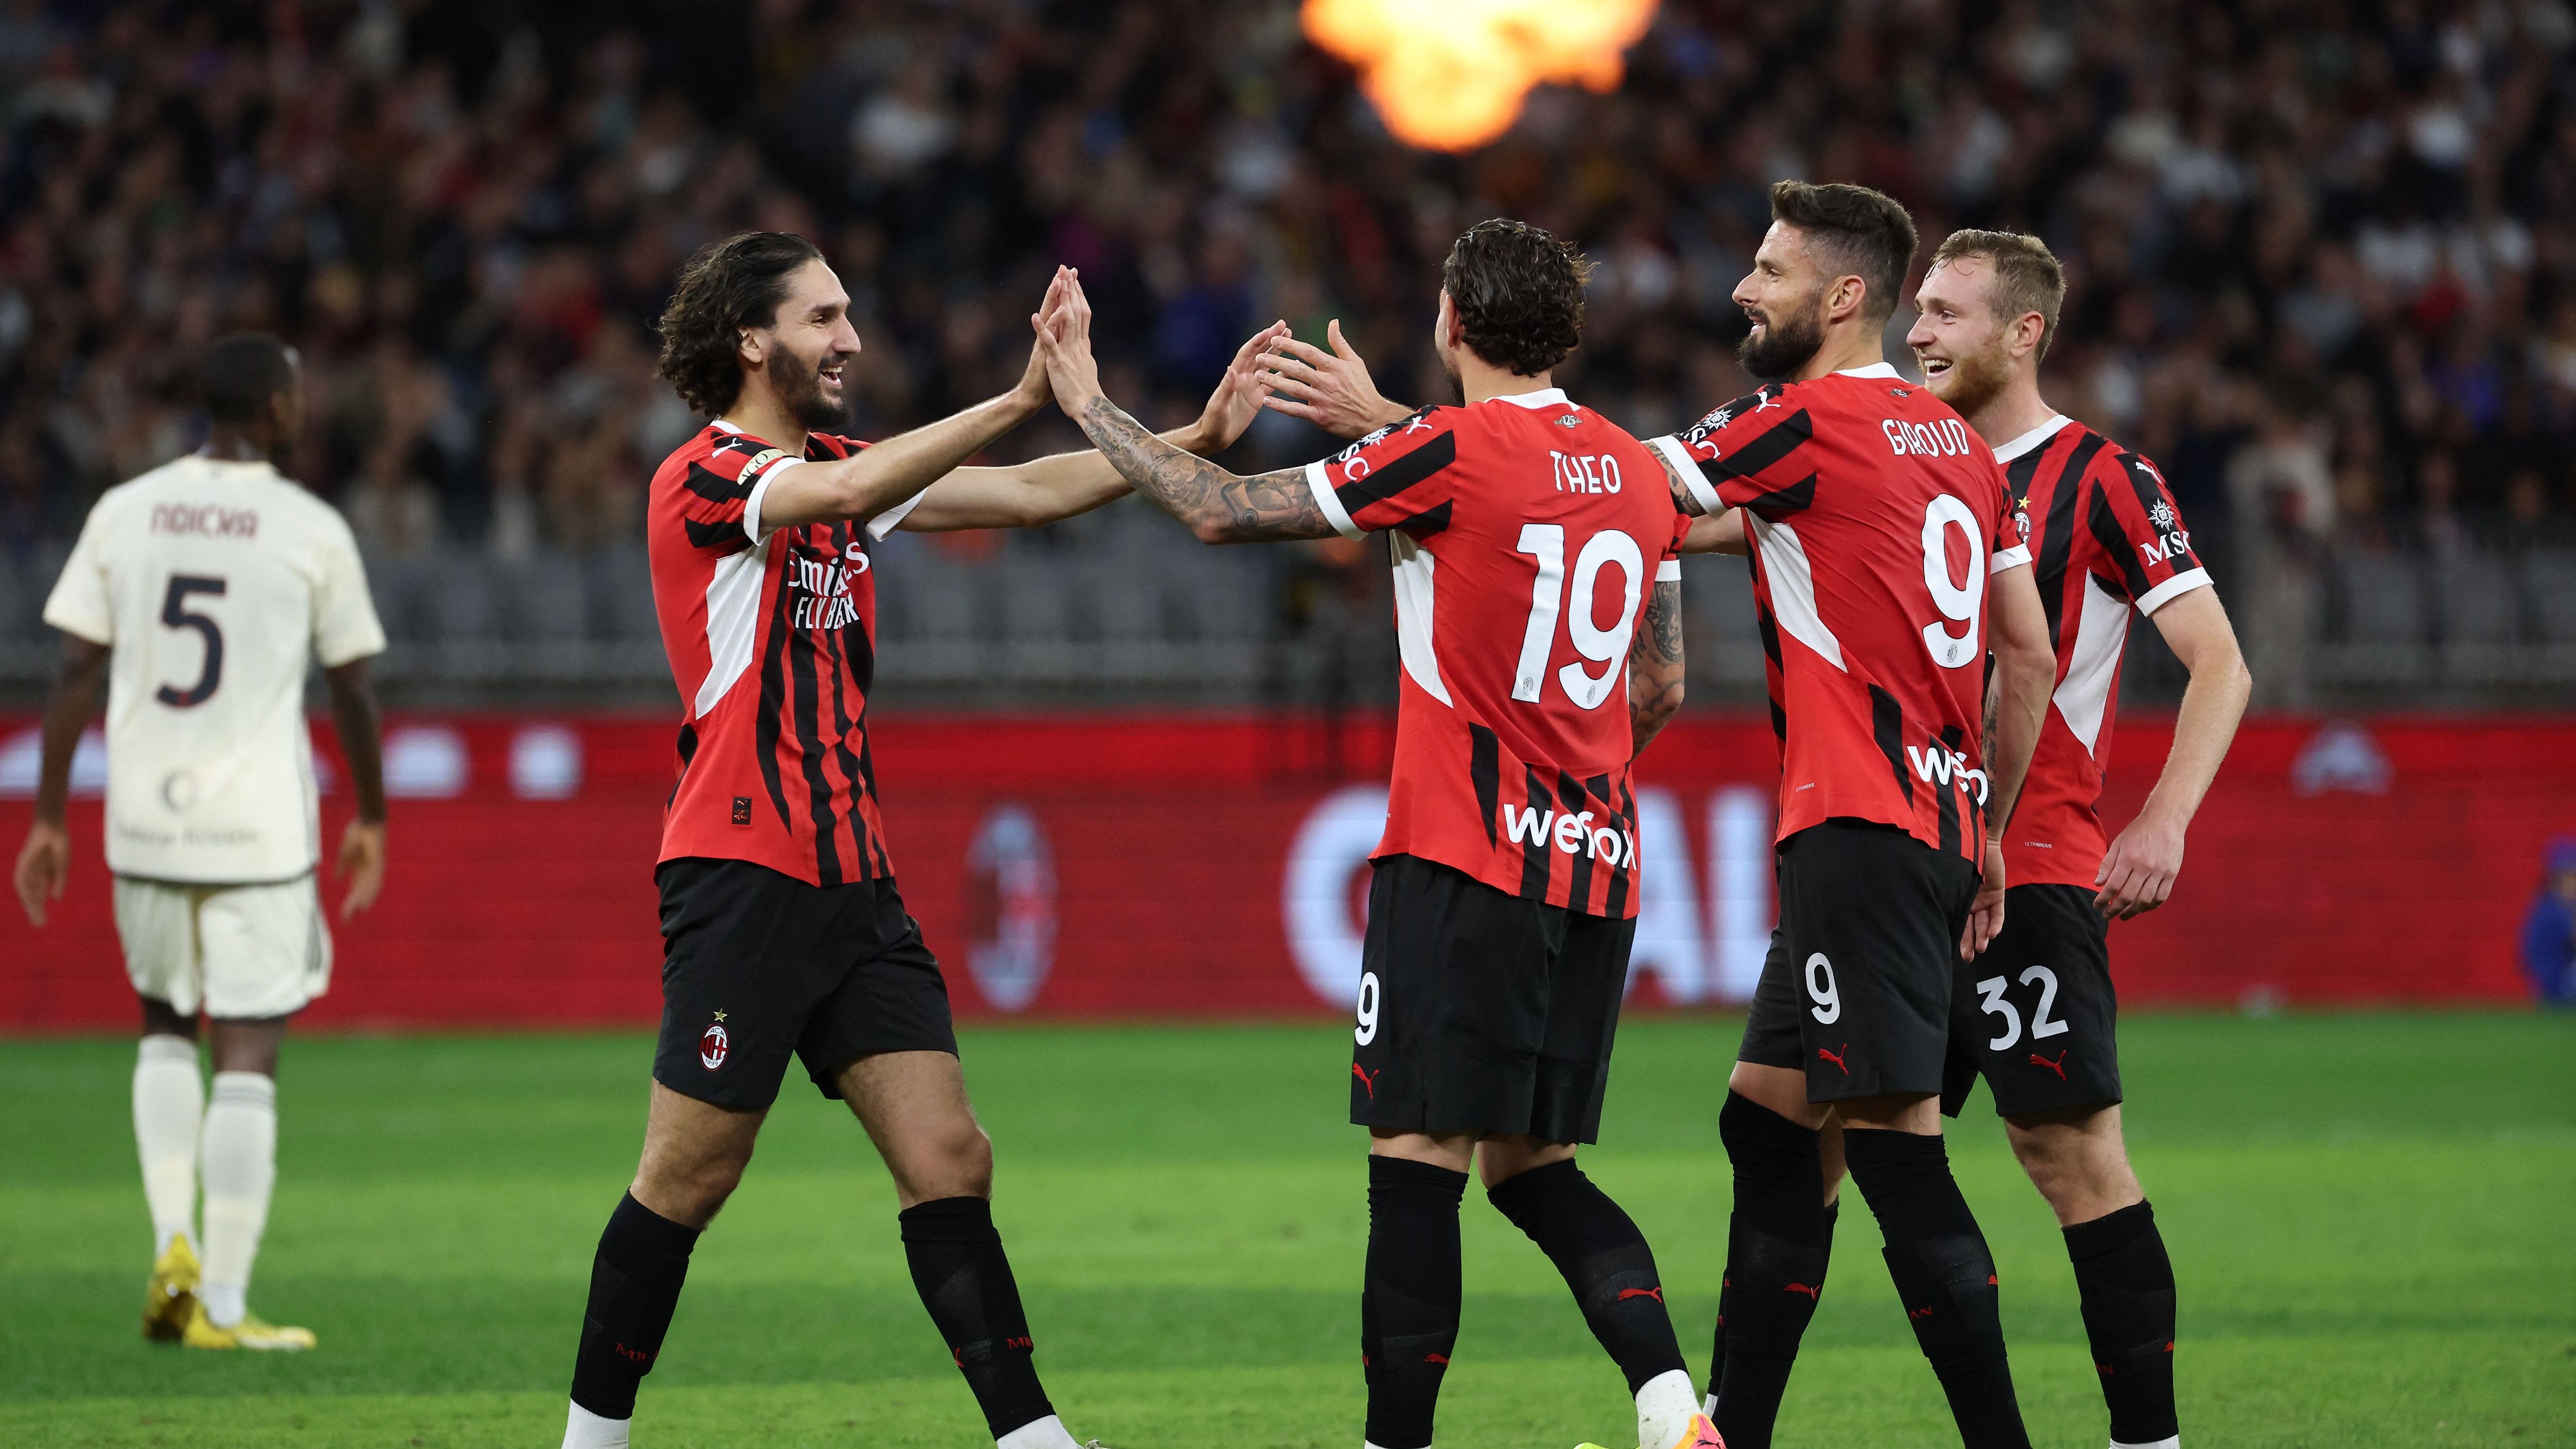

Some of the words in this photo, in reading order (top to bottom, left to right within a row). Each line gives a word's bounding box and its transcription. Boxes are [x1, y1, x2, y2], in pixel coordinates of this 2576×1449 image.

[1338, 443, 1370, 480] SC
[1882, 418, 1970, 458] GIROUD
[1550, 450, 1621, 494] THEO
[795, 597, 827, 629] FLY
[1921, 493, 1984, 668] 9
[156, 574, 227, 708] 5
[1510, 523, 1643, 710] 19
[1503, 804, 1637, 871] wefox
[1805, 952, 1840, 1024] 9
[1976, 965, 2069, 1051] 32
[709, 1027, 725, 1038] ACM
